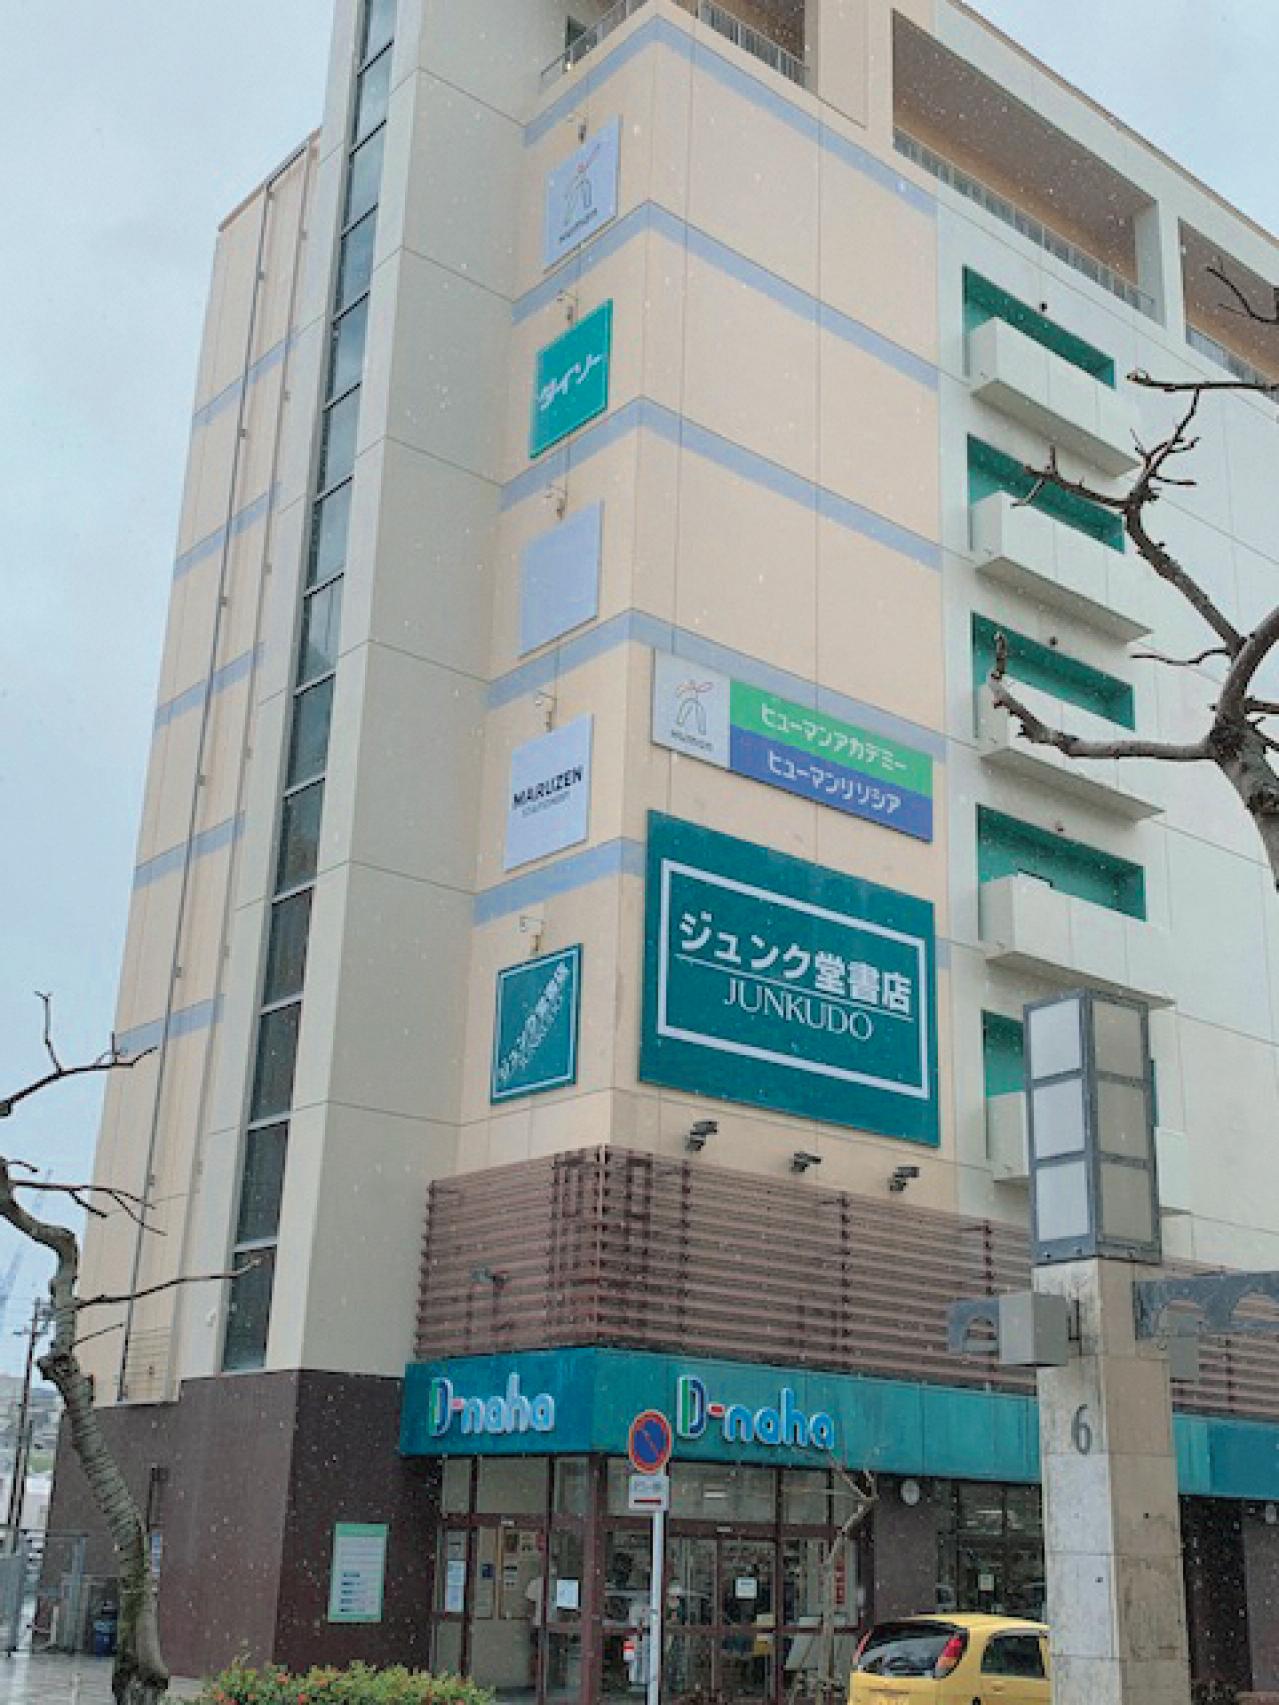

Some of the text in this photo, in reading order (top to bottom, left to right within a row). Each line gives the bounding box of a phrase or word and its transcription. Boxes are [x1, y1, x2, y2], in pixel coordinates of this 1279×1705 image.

[760, 702, 907, 771] ヒューマンアカデミー
[513, 764, 584, 810] MARUZEN
[679, 909, 912, 1014] ジュンク堂書店
[724, 976, 875, 1041] JUNKUDO
[429, 1372, 555, 1437] D-naha
[676, 1375, 836, 1450] D-naha
[1071, 1403, 1092, 1456] 6
